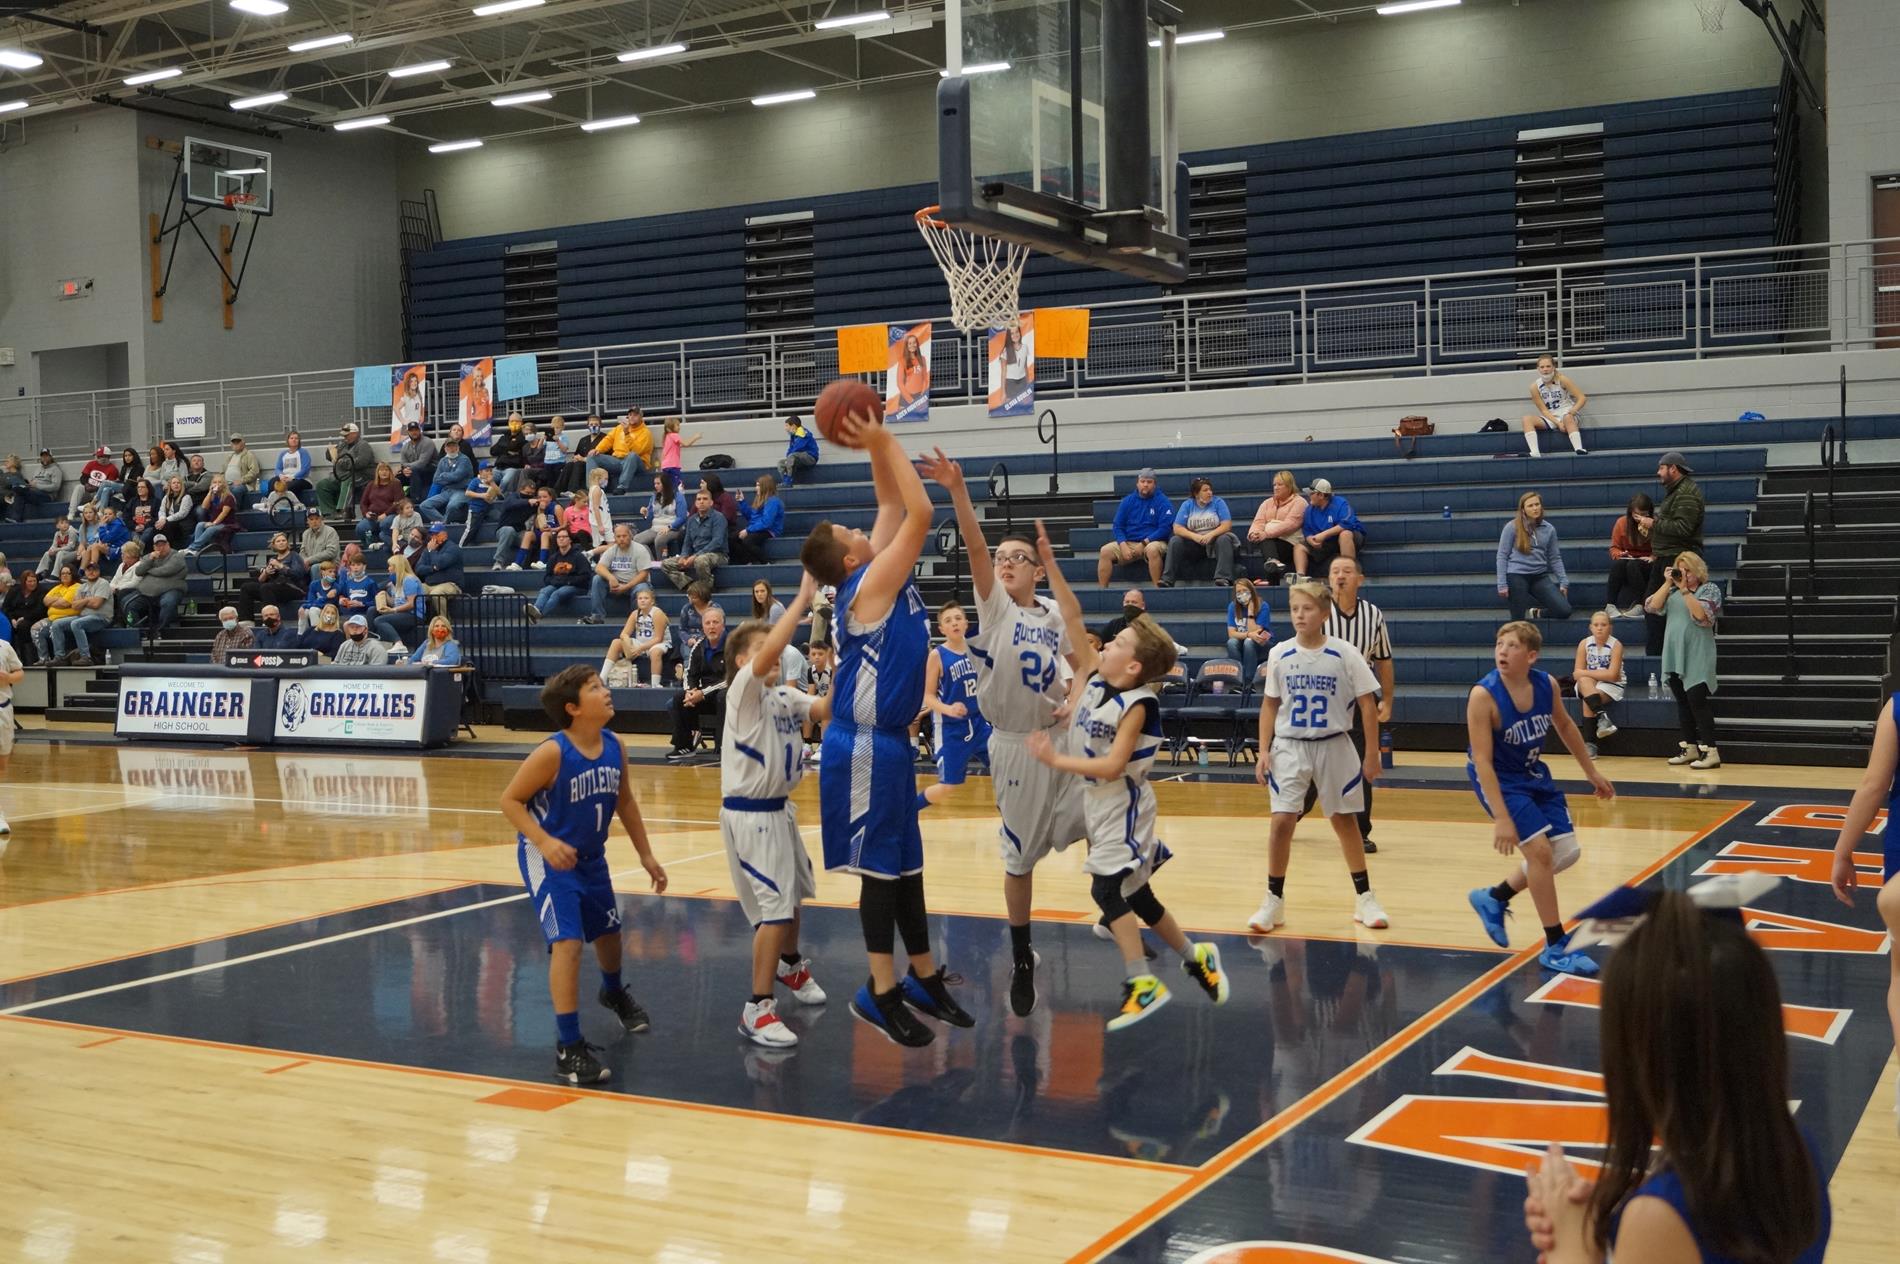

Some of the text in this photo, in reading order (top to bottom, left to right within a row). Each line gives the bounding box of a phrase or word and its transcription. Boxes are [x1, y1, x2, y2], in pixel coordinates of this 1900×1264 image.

[176, 416, 203, 425] VISITORS
[261, 656, 277, 665] POSS
[1020, 651, 1056, 693] 24
[963, 678, 977, 698] 12
[1286, 674, 1337, 696] BUCCANEERS
[124, 690, 244, 718] GRAINGER
[310, 692, 416, 719] GRIZZLIES
[1291, 694, 1327, 728] 22
[153, 721, 210, 731] HIGH SCHOOL
[595, 802, 603, 832] 1
